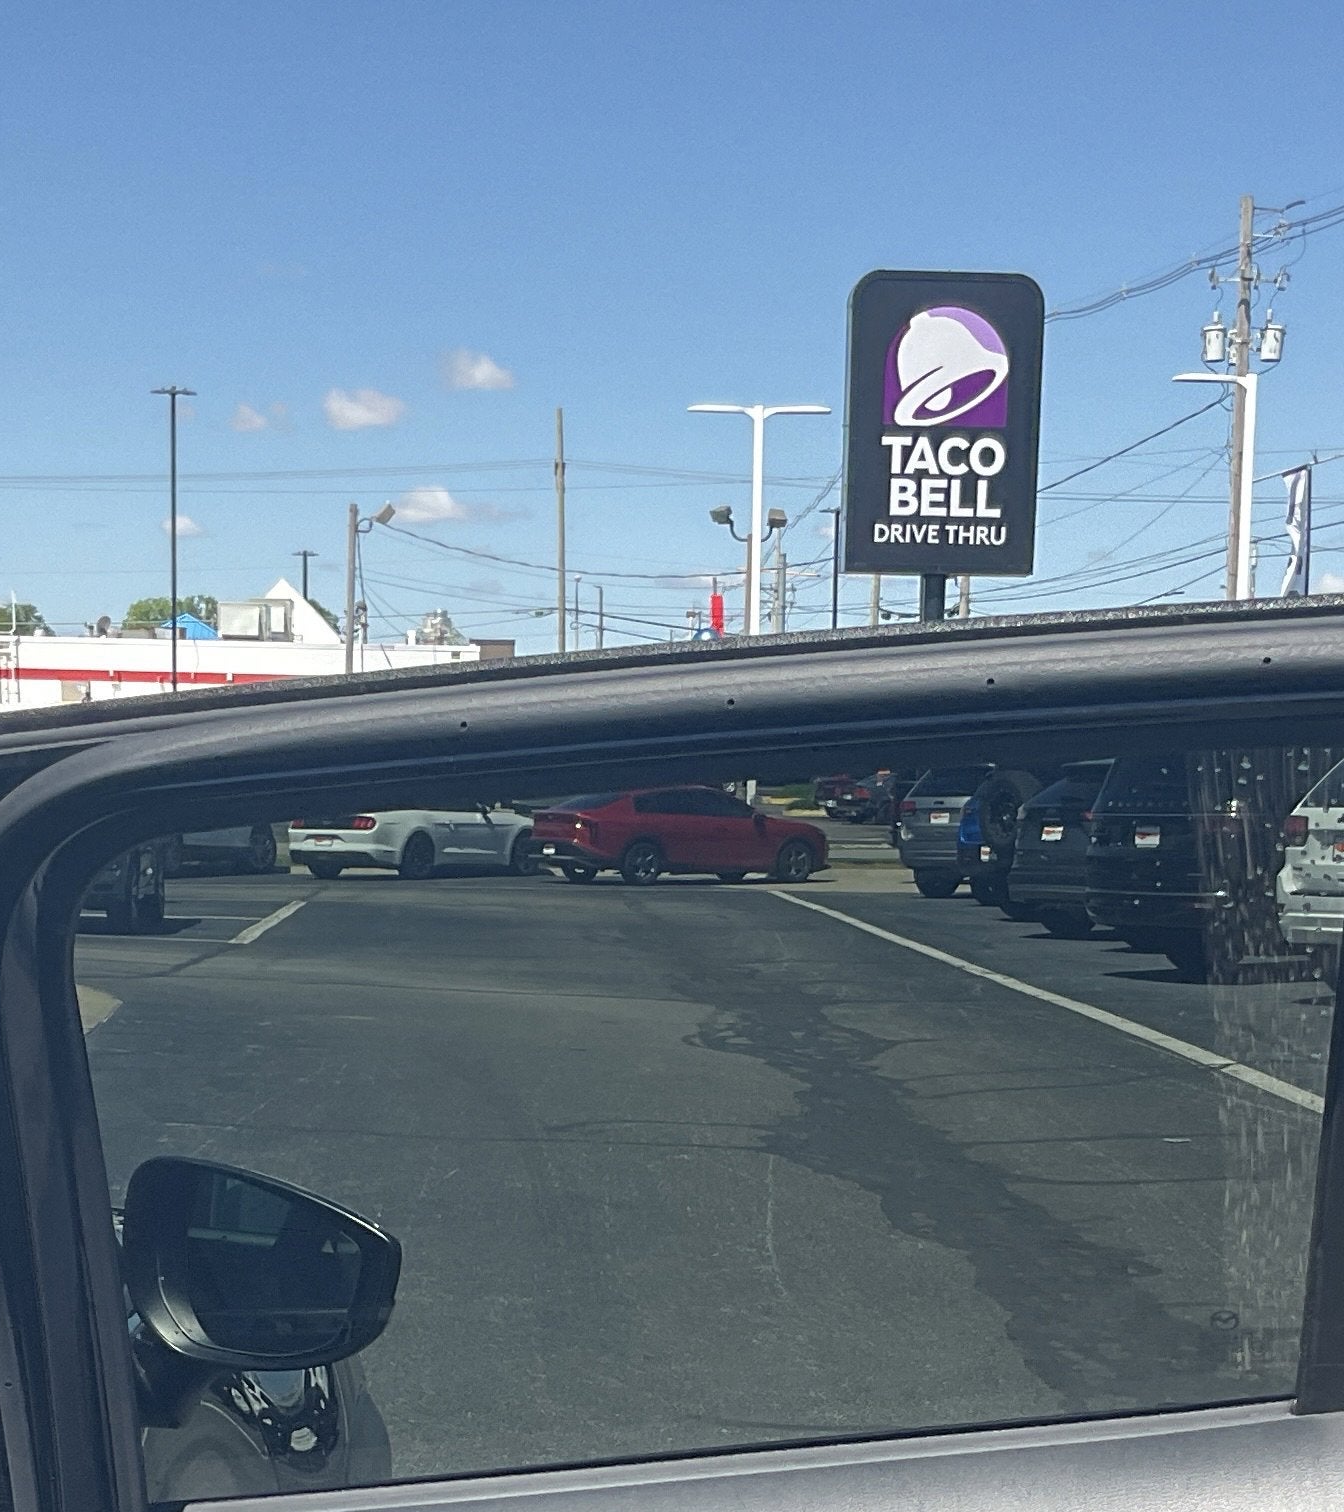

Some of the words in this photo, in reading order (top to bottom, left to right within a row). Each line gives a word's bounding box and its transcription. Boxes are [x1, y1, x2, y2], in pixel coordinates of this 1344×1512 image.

[881, 436, 1006, 476] TACO
[889, 478, 1001, 518] BELL
[873, 523, 941, 544] DRIVE
[945, 525, 1007, 545] THRU
